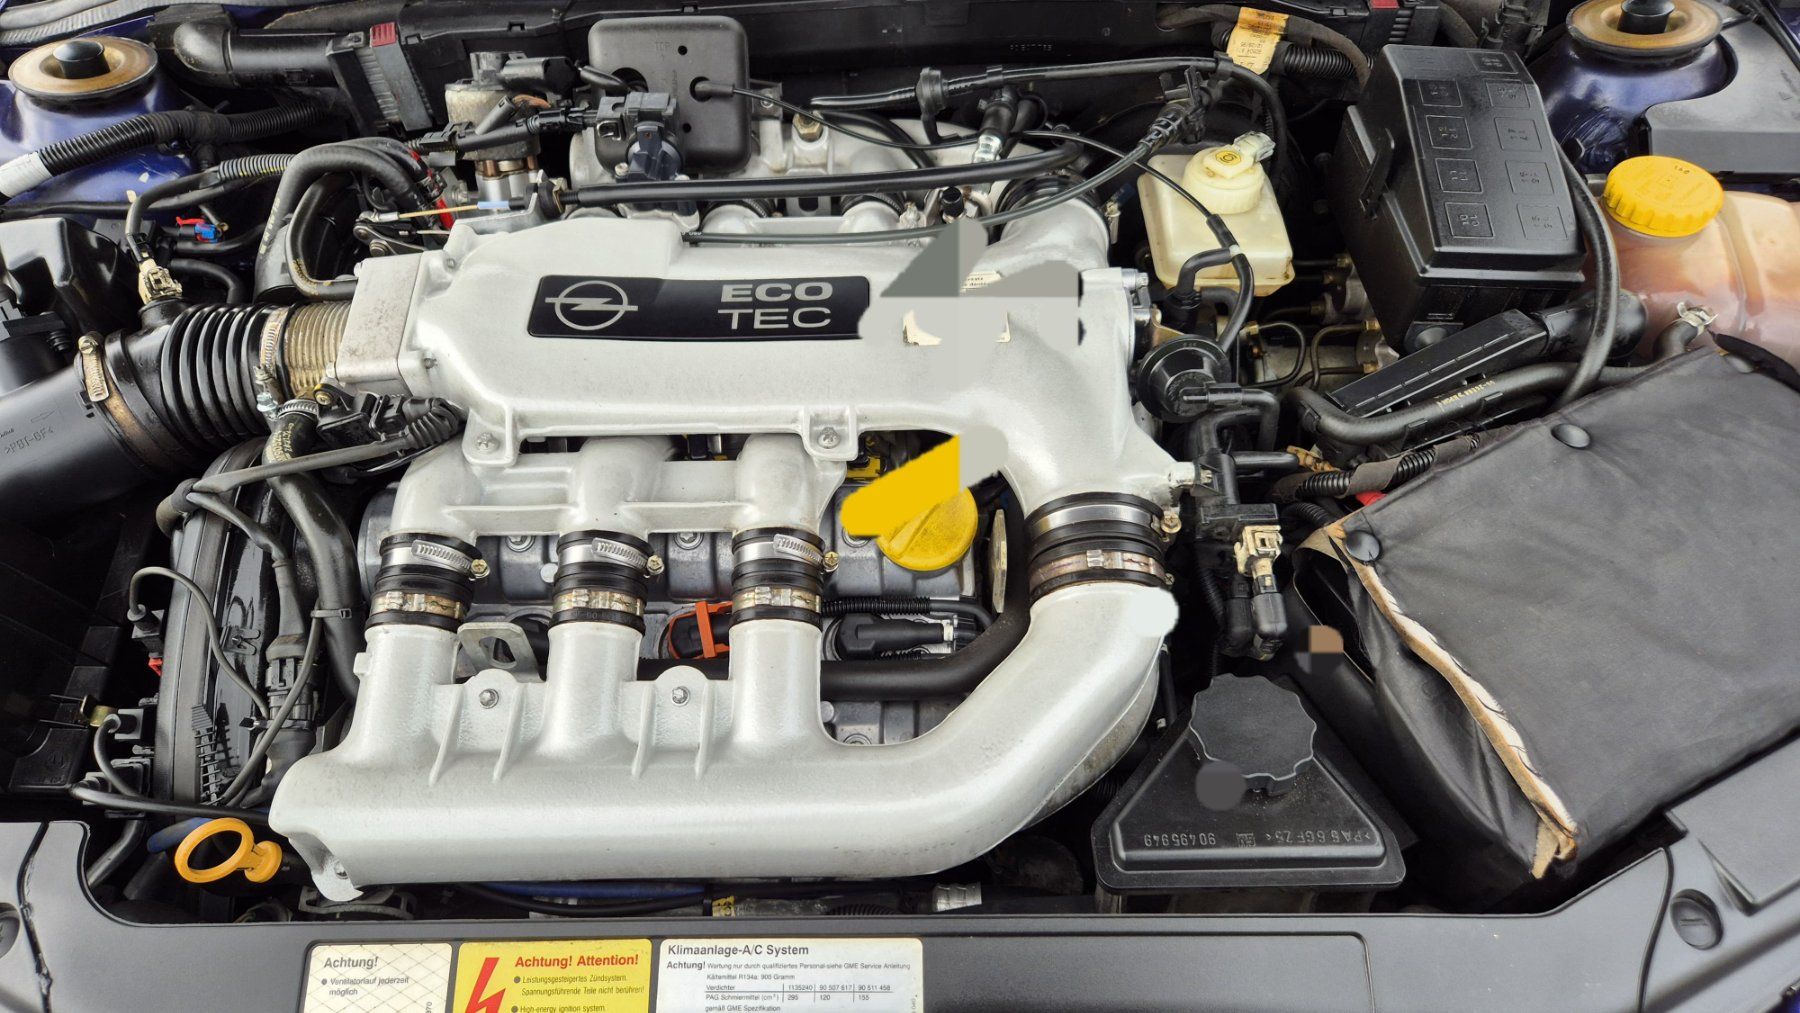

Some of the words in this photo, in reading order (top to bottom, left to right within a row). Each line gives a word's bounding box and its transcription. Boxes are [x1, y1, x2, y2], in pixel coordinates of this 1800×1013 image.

[720, 282, 833, 302] ECO
[717, 307, 831, 329] TEC
[668, 945, 763, 957] Klimaanlage-A/C
[766, 945, 809, 957] System
[324, 956, 379, 970] Achtung!
[515, 955, 573, 969] Achtung!
[577, 954, 639, 966] Attention!
[667, 961, 706, 970] Achtung!
[883, 962, 911, 970] Anleitung
[330, 977, 377, 986] Ventilatorlauf
[378, 976, 410, 987] jederzeit
[522, 975, 587, 985] Leistungsgesteigertes
[329, 988, 358, 998] möglich
[521, 987, 580, 997] Spannungsführende
[583, 987, 597, 995] Teile
[598, 986, 614, 994] nicht
[520, 1005, 557, 1013] High-energy
[559, 1005, 580, 1013] ignition
[582, 1004, 606, 1013] system
[743, 1004, 781, 1012] Spezifikation
